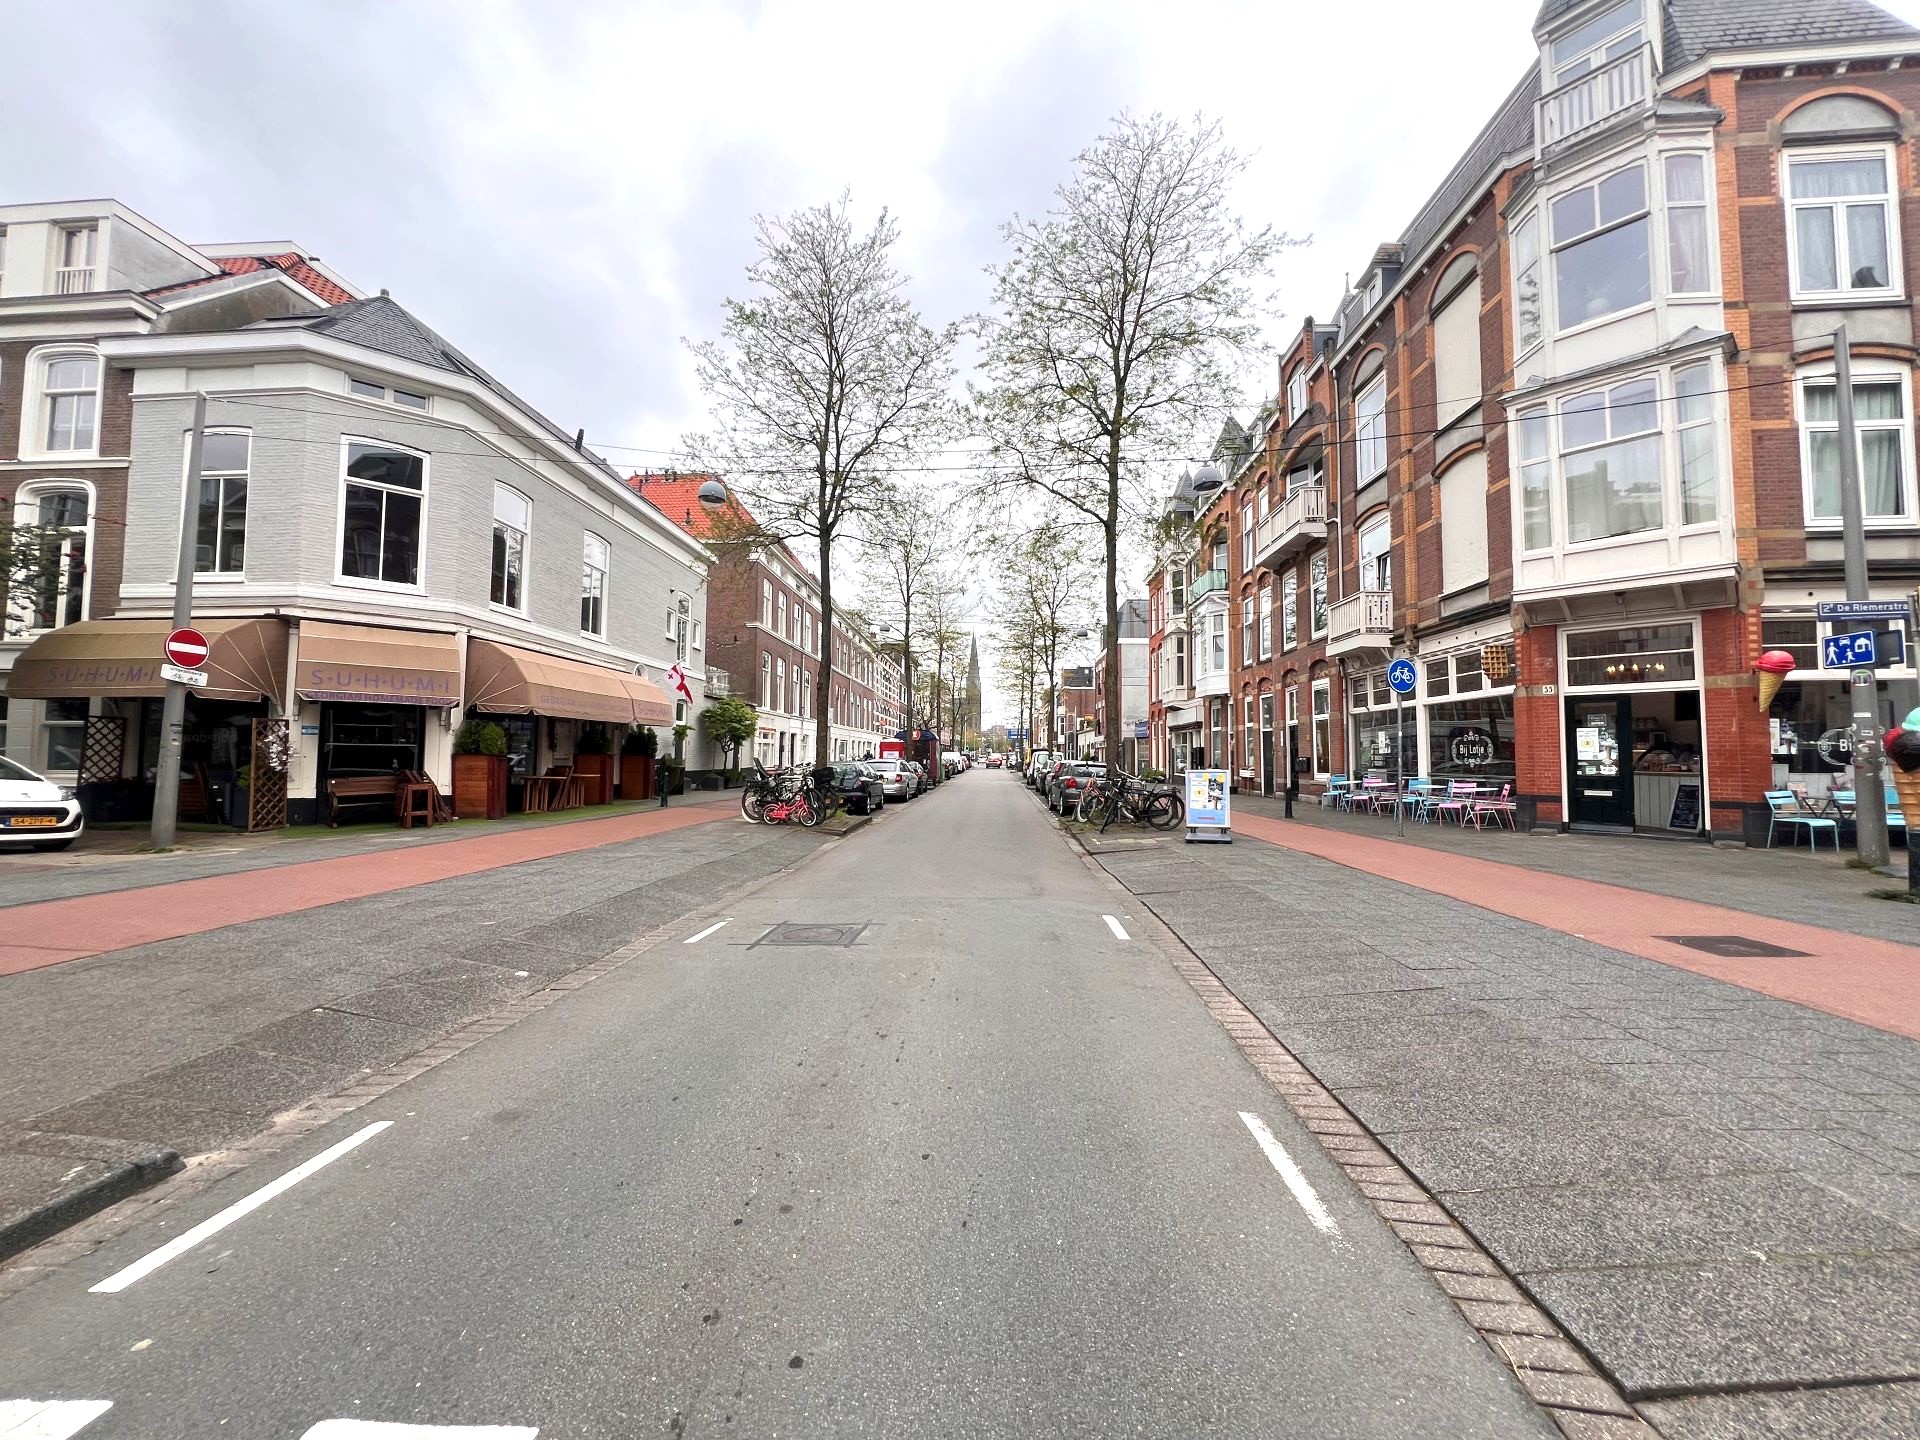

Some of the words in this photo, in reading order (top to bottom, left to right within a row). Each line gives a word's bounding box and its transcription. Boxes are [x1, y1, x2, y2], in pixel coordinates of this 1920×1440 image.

[1837, 604, 1850, 612] De
[1853, 603, 1908, 612] Riemerstra
[1459, 744, 1468, 757] Bij
[1469, 744, 1485, 757] Lotje
[1839, 738, 1853, 752] Bi
